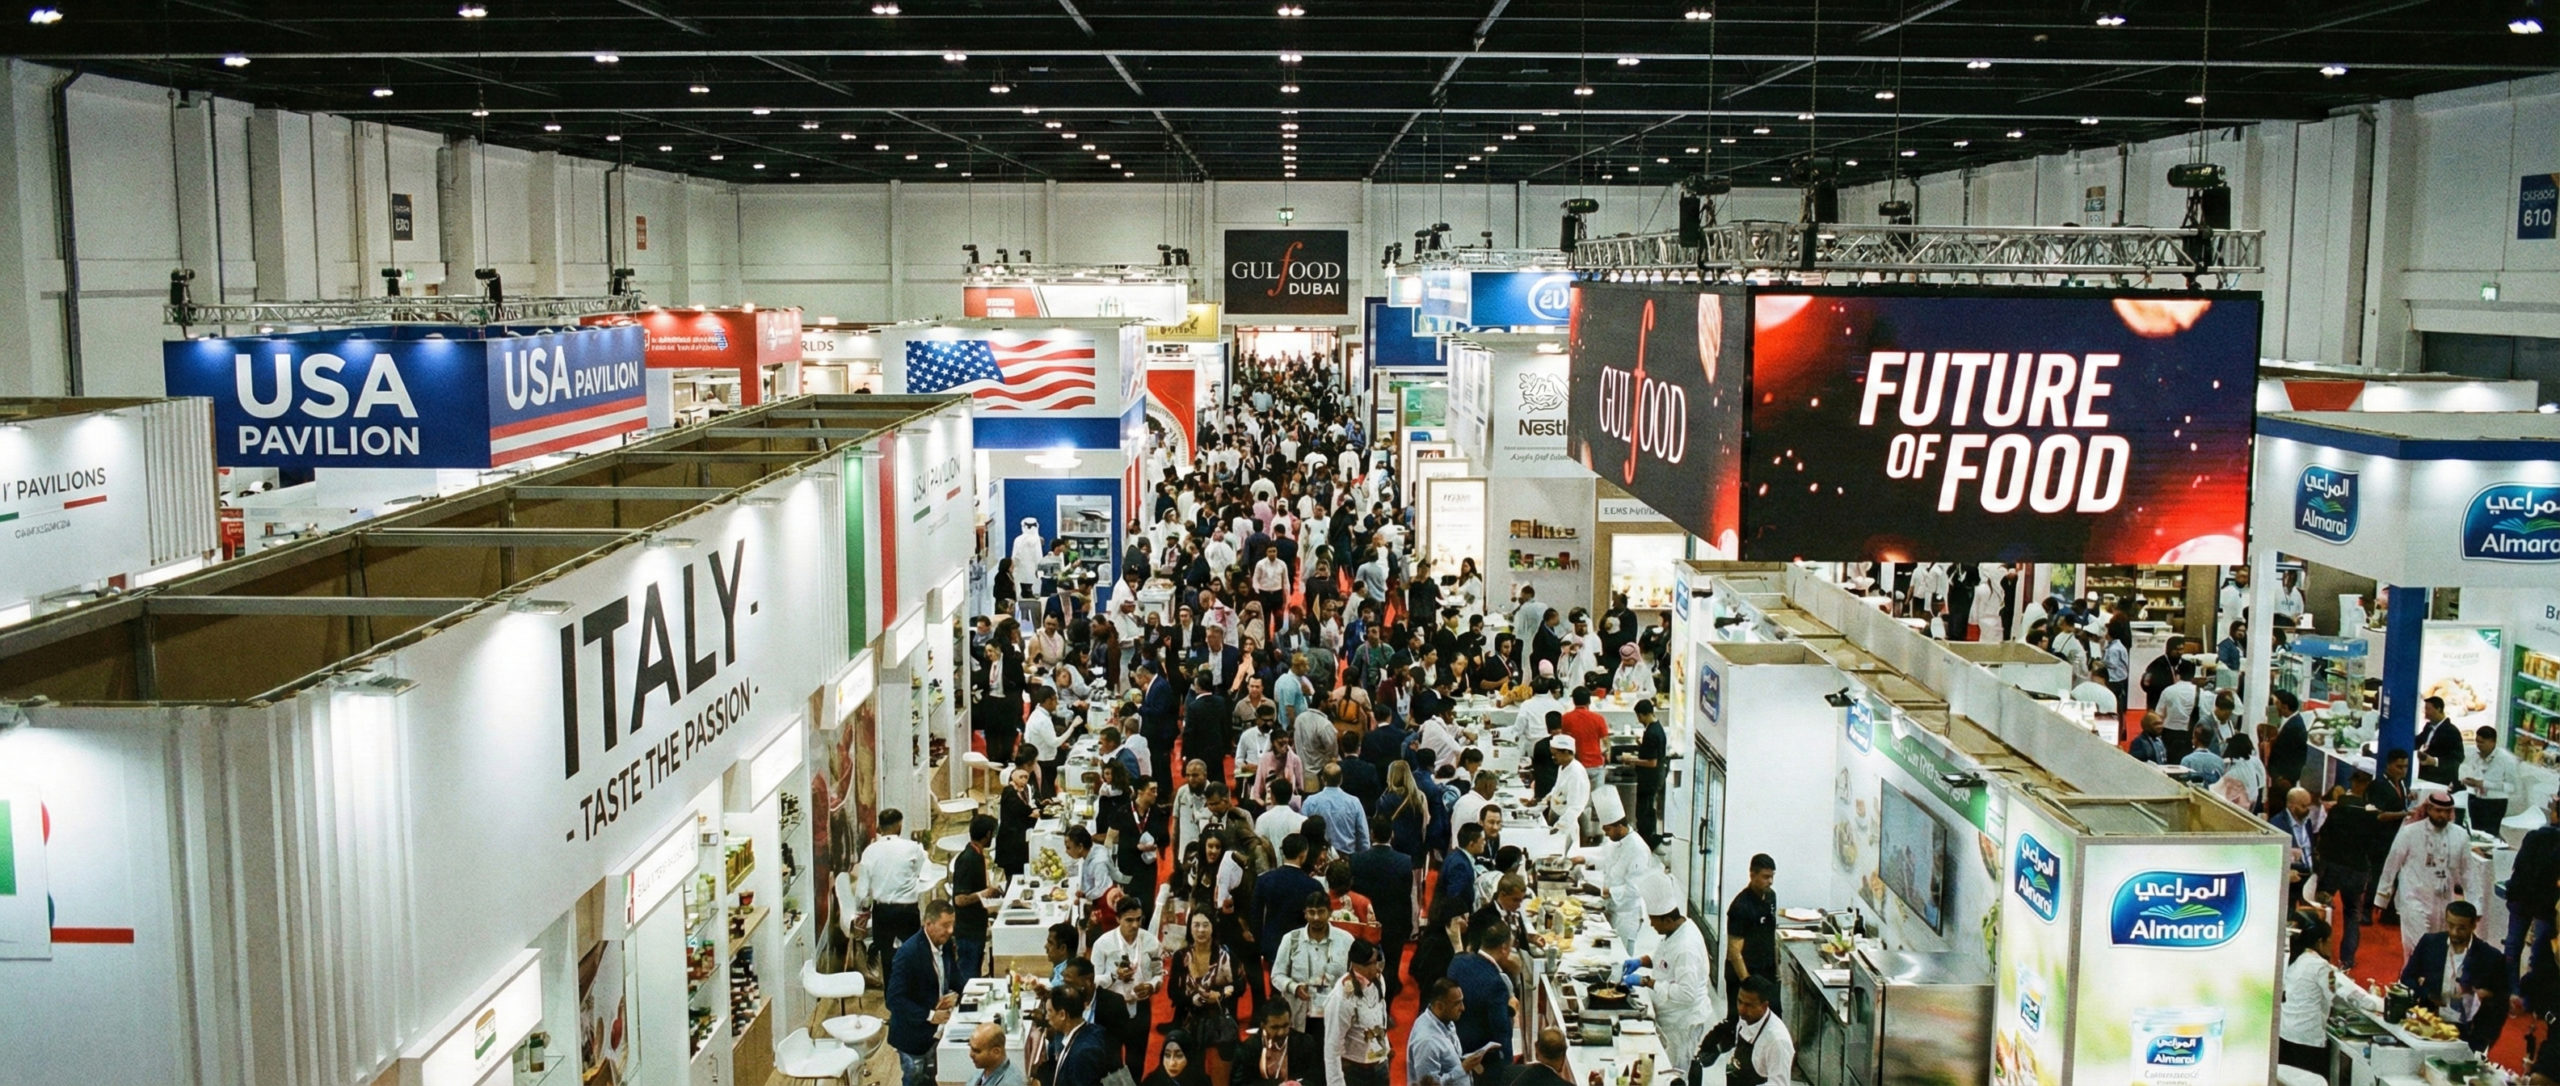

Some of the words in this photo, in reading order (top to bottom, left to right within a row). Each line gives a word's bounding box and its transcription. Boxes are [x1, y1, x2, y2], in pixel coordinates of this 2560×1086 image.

[1288, 282, 1341, 296] DUBAI
[800, 340, 834, 351] RLDS
[235, 353, 419, 419] USA
[505, 345, 573, 411] USA
[575, 361, 639, 398] PAVILION
[1858, 351, 2121, 428] FUTURE
[238, 425, 419, 456] PAVILION
[1518, 418, 1567, 437] Nestl
[16, 467, 106, 500] PAVILIONS
[1885, 432, 1942, 479] OF
[1937, 432, 2131, 514] FOOD
[2304, 473, 2350, 500] المراعي
[2485, 490, 2560, 518] مراعي
[2302, 508, 2348, 536] Almarai
[2480, 533, 2560, 553] Almara
[580, 759, 642, 842] TASTE
[645, 730, 681, 790] THE
[685, 677, 750, 761] PASSION
[2134, 877, 2227, 904] المراعي
[2130, 918, 2225, 941] Almarai
